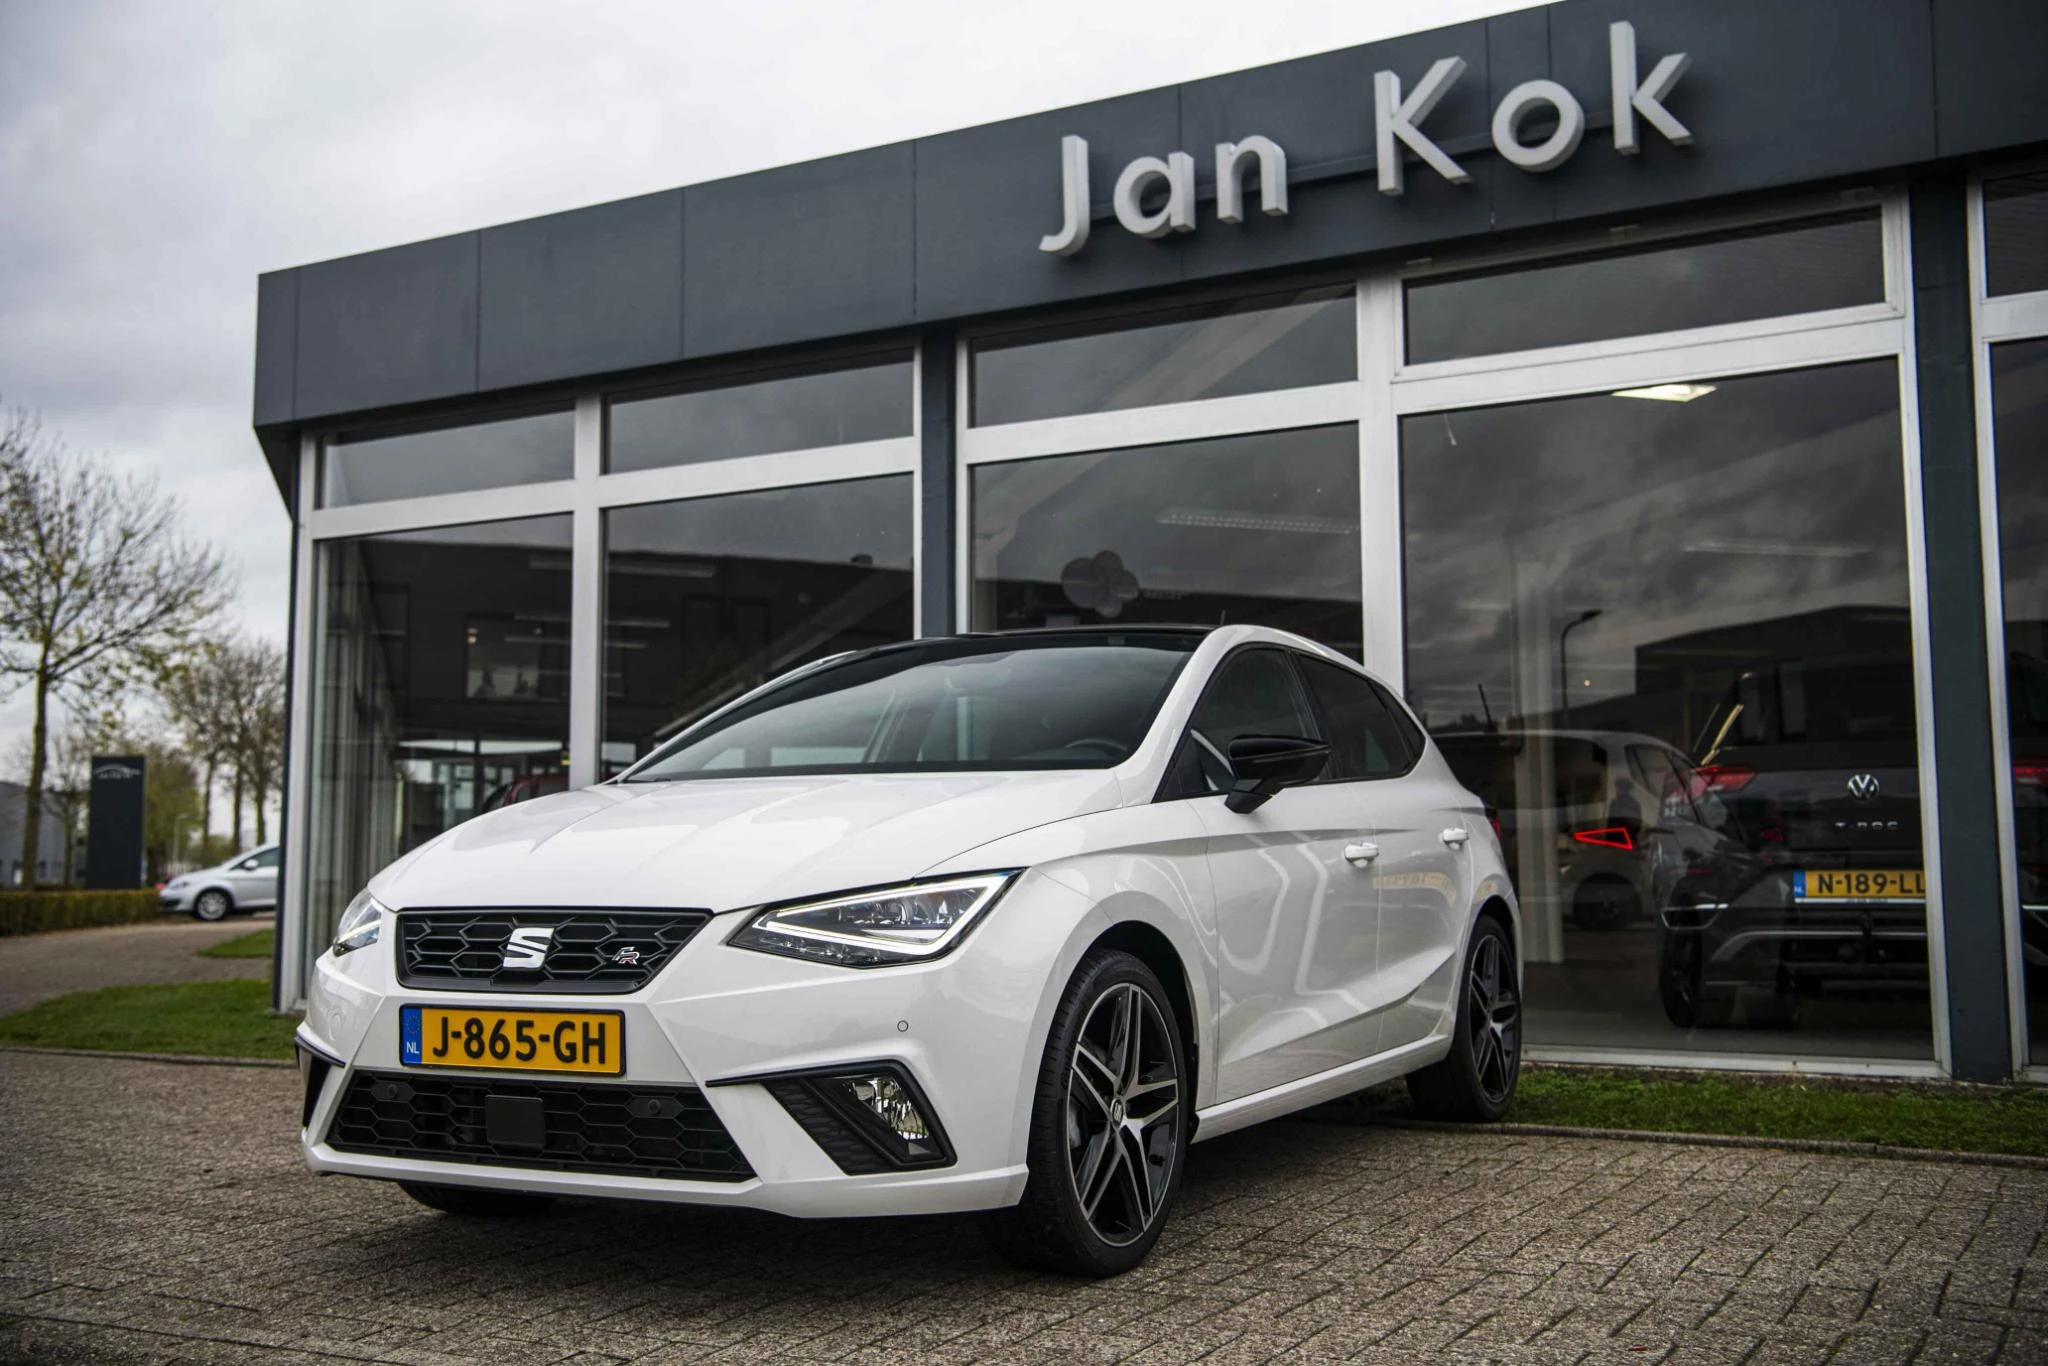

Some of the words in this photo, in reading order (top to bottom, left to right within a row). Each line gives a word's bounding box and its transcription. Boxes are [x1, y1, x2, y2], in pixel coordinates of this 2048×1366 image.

[1038, 135, 1288, 256] Jan
[1374, 21, 1694, 196] Kok
[1818, 872, 1926, 894] N-189-LL
[406, 1042, 420, 1055] NL
[433, 1017, 606, 1065] J-865-GH
